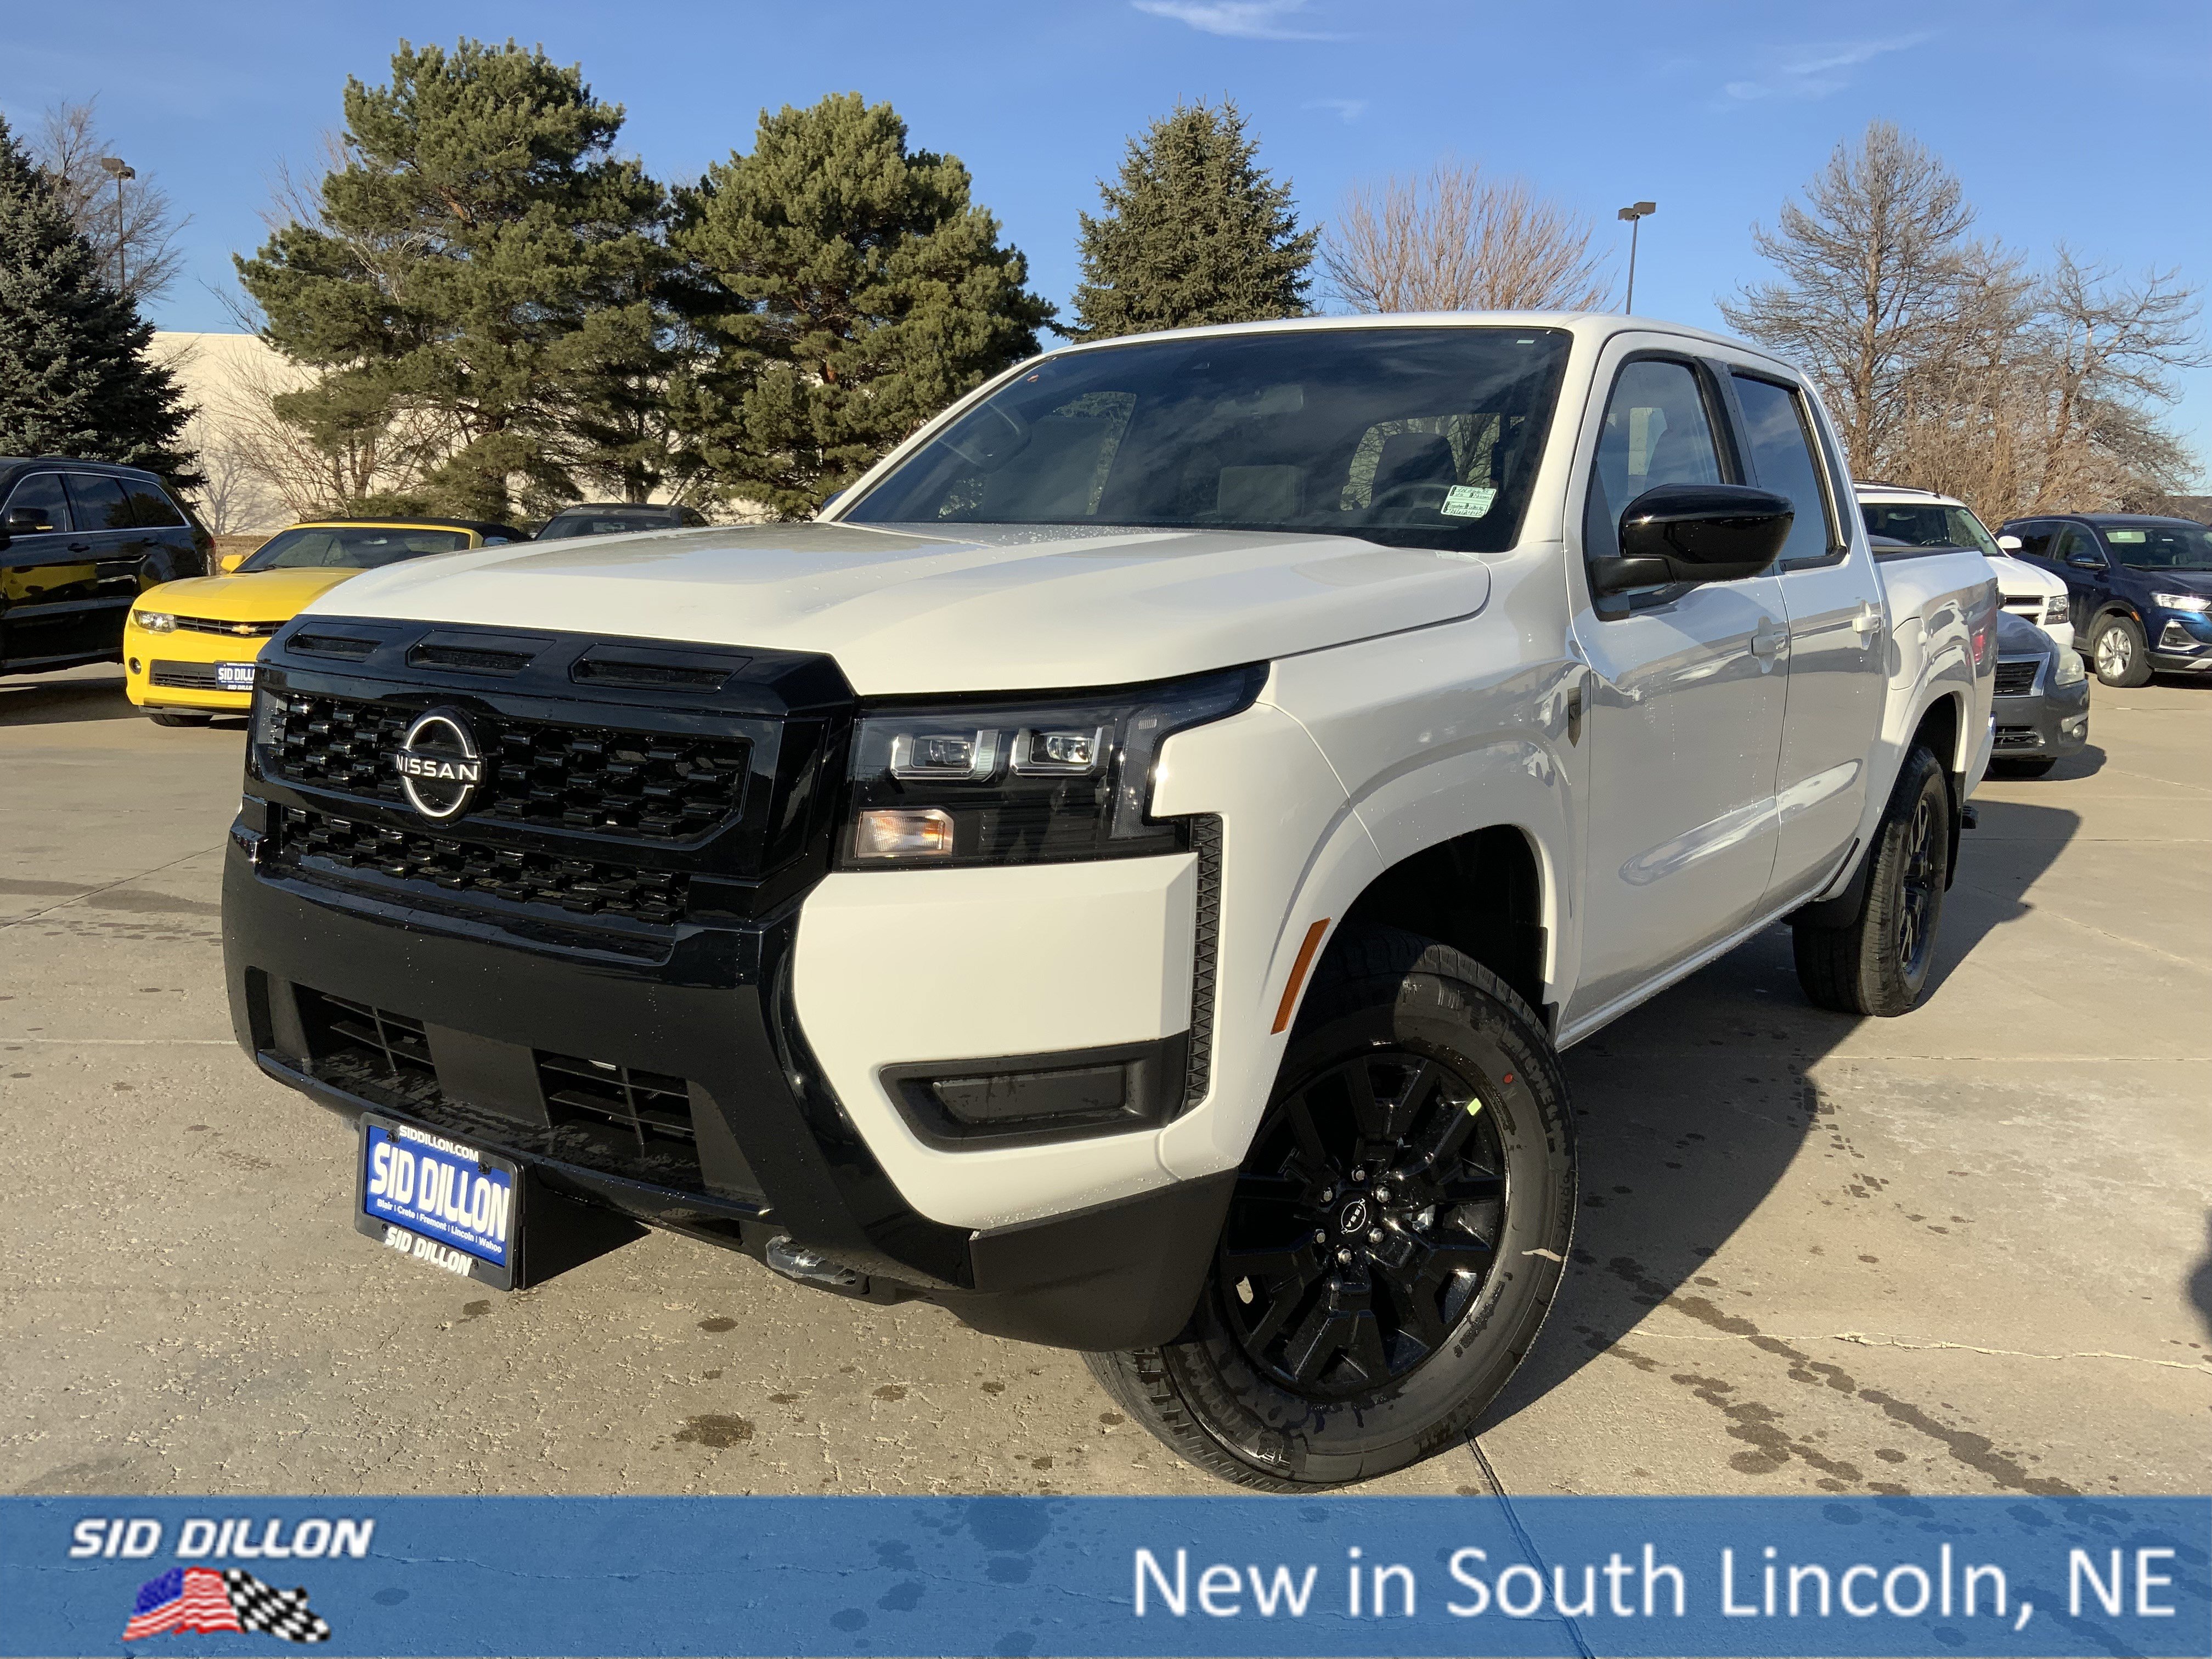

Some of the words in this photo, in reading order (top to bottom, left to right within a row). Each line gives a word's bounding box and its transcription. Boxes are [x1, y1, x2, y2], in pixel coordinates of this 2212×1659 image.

[218, 668, 233, 680] SID
[396, 754, 478, 781] NISSAN
[399, 1125, 479, 1163] SIDDILLON.COM
[370, 1142, 415, 1204] SID
[419, 1156, 510, 1242] DILLON
[377, 1199, 393, 1212] Blair
[397, 1205, 415, 1220] Crete
[420, 1213, 447, 1232] Fremont
[451, 1226, 474, 1243] Lincoln
[479, 1236, 502, 1254] Wahoo
[1341, 1198, 1365, 1235] NISSAN
[386, 1227, 413, 1253] SID
[414, 1238, 473, 1277] DILLON
